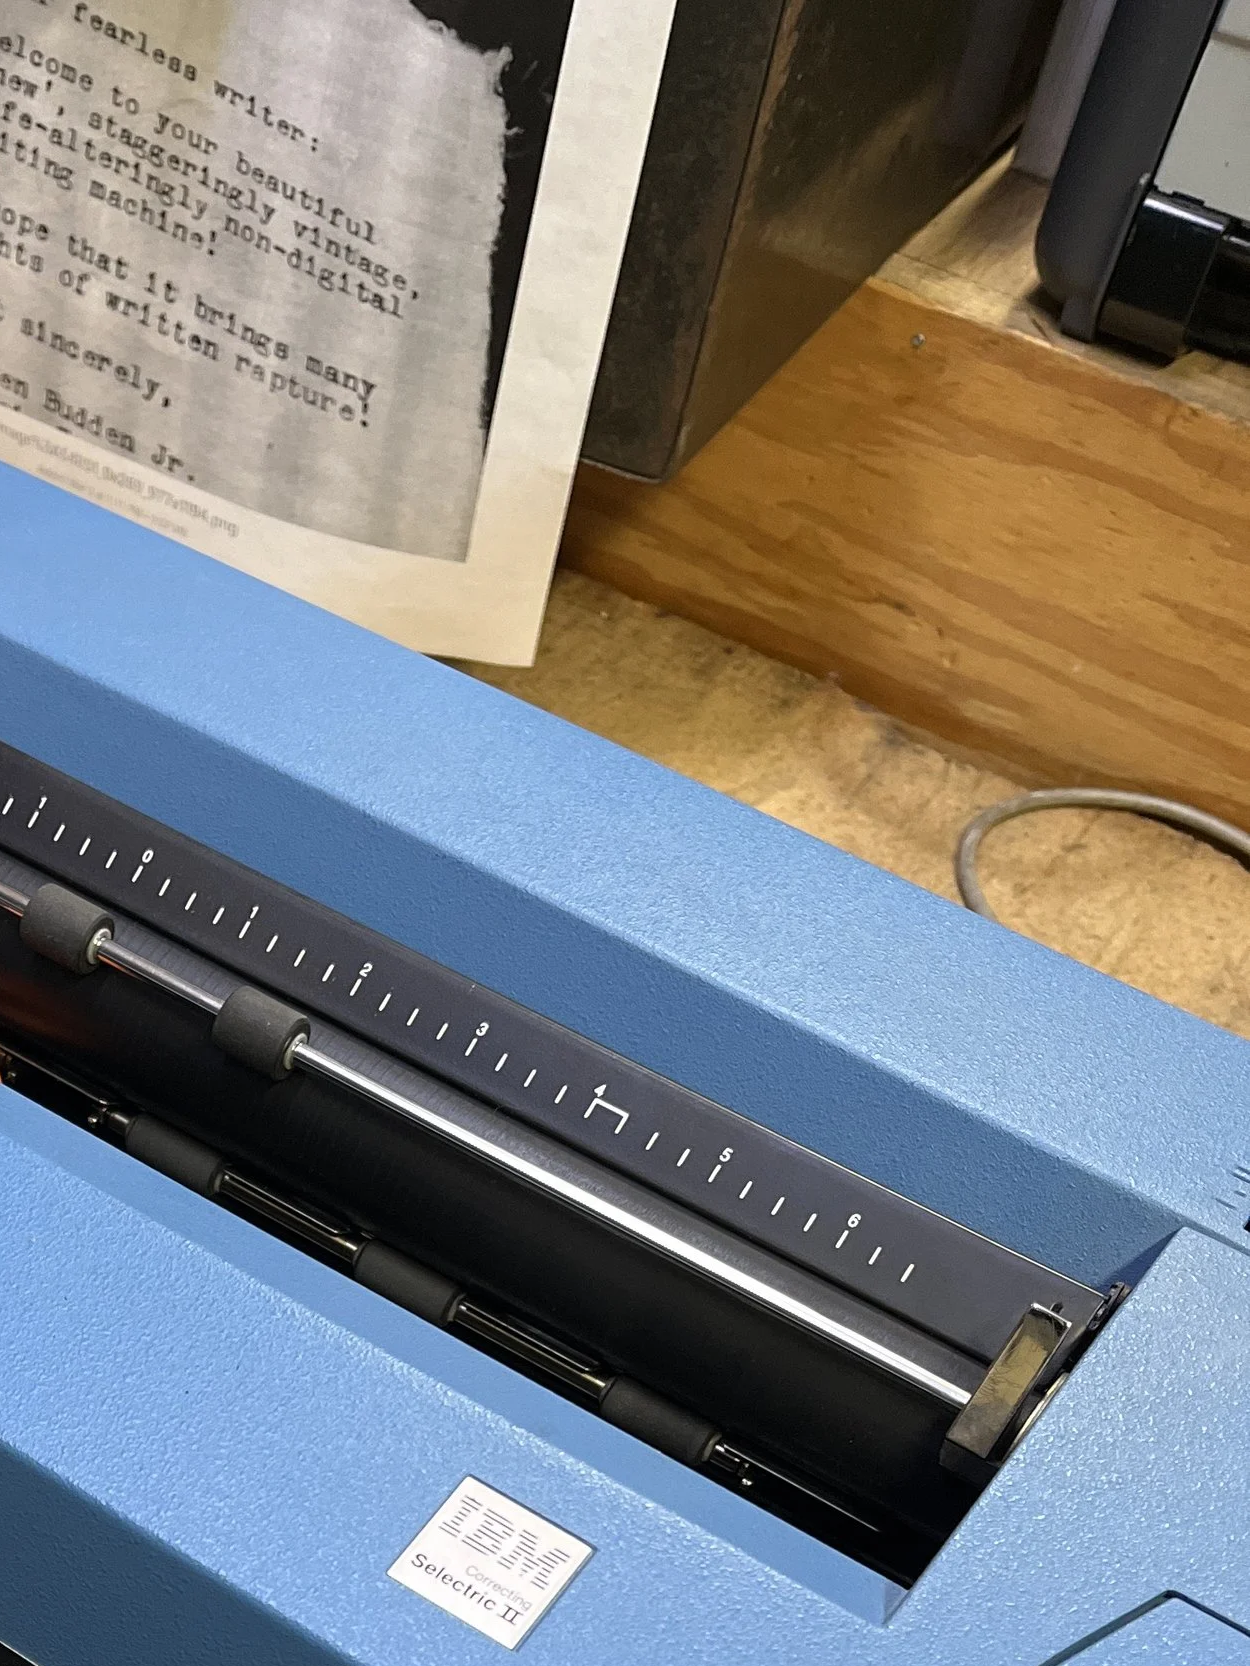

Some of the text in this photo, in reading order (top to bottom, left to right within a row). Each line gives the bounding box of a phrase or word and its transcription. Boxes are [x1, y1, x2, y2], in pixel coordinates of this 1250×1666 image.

[73, 2, 319, 152] fearless writer:
[87, 110, 276, 225] staggeringly
[293, 220, 419, 300] vintage,
[111, 85, 139, 115] to
[153, 112, 218, 155] your
[236, 151, 377, 245] beautiful
[88, 179, 218, 256] machine!
[224, 215, 403, 319] non-digital
[21, 317, 171, 408] sincerely,
[59, 269, 91, 295] of
[106, 291, 220, 360] written
[234, 353, 370, 428] rapture!
[68, 234, 130, 280] that
[145, 271, 178, 303] it
[194, 294, 290, 360] brings
[306, 355, 377, 400] many
[43, 387, 136, 452] Budden
[150, 444, 196, 481] Jr.
[142, 849, 154, 864] 0
[250, 905, 259, 919] 1
[359, 962, 373, 977] 2
[475, 1022, 490, 1036] 3
[593, 1083, 607, 1097] 4
[719, 1147, 734, 1163] 5
[847, 1213, 862, 1228] 6
[410, 1553, 497, 1611] Selectric
[437, 1494, 571, 1591] IBM
[465, 1565, 533, 1612] Correcting
